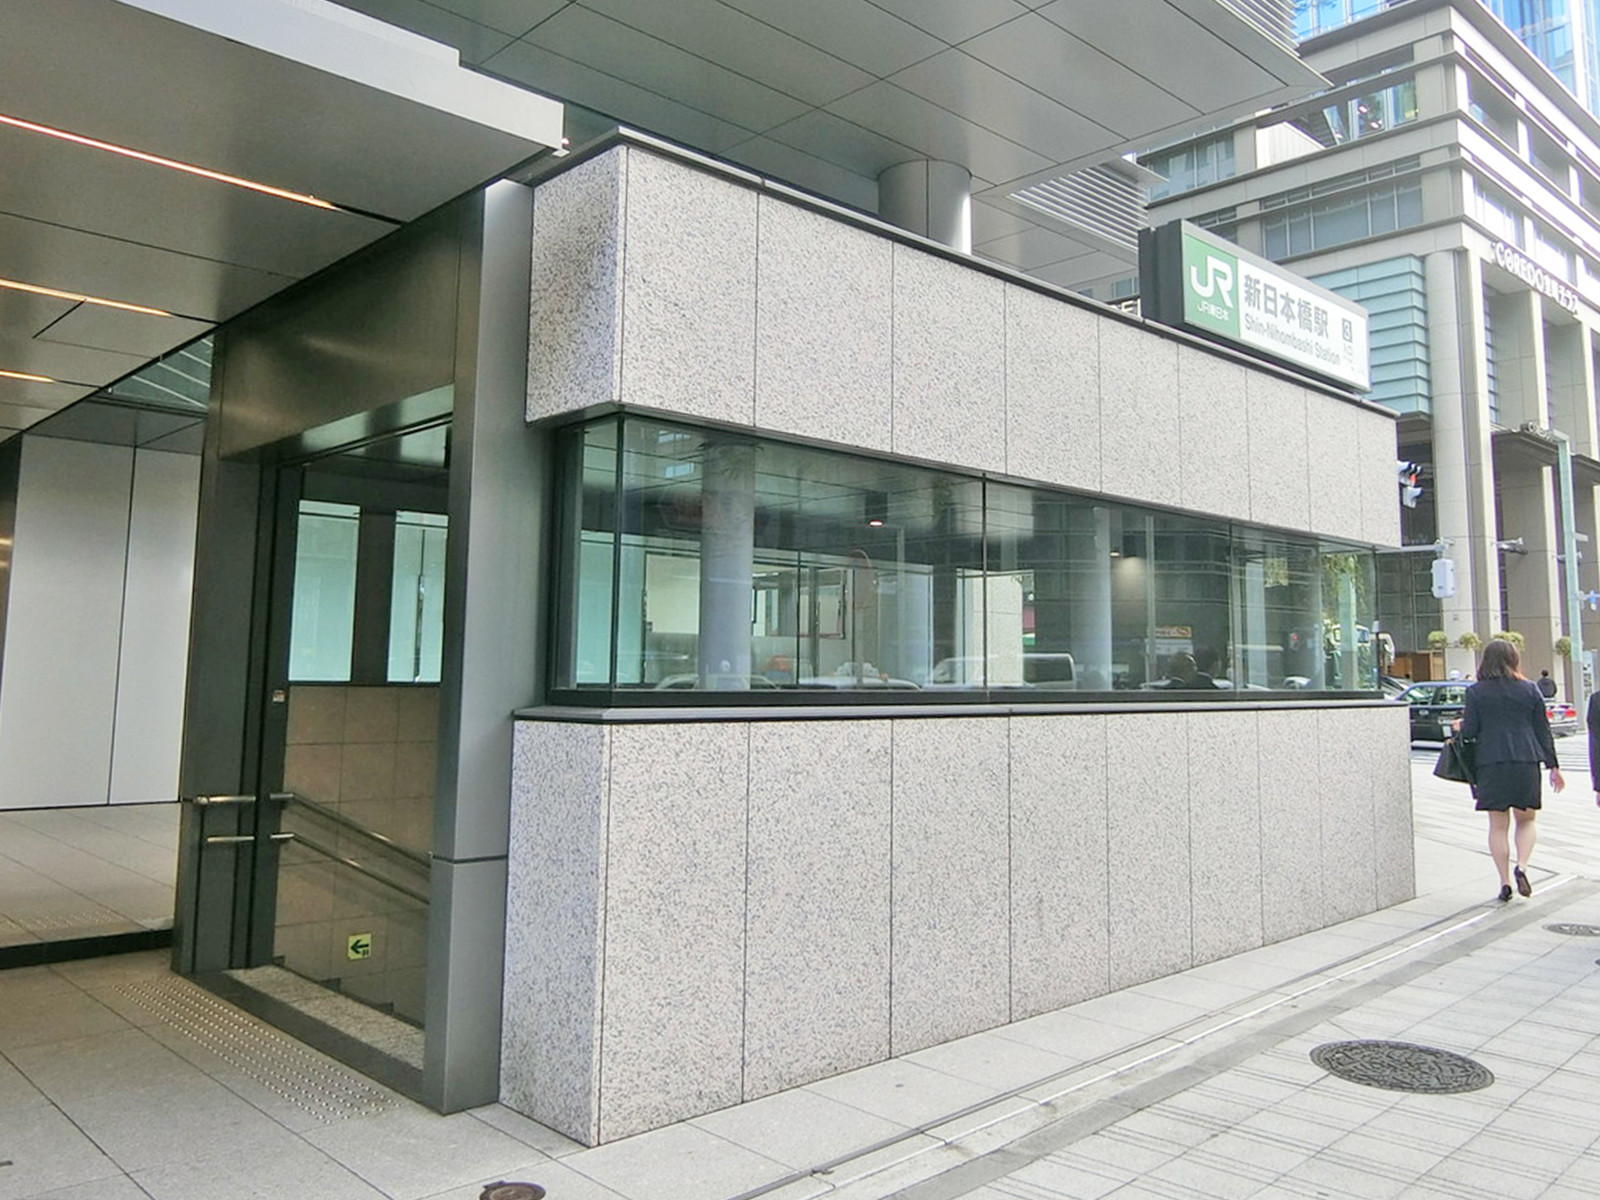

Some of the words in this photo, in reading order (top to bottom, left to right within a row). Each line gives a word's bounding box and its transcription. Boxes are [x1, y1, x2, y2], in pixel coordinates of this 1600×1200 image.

[1190, 255, 1234, 309] JR
[1243, 274, 1330, 339] 新日本橋駅
[1244, 313, 1314, 357] Shin-Nihombashi
[1315, 341, 1341, 365] Station
